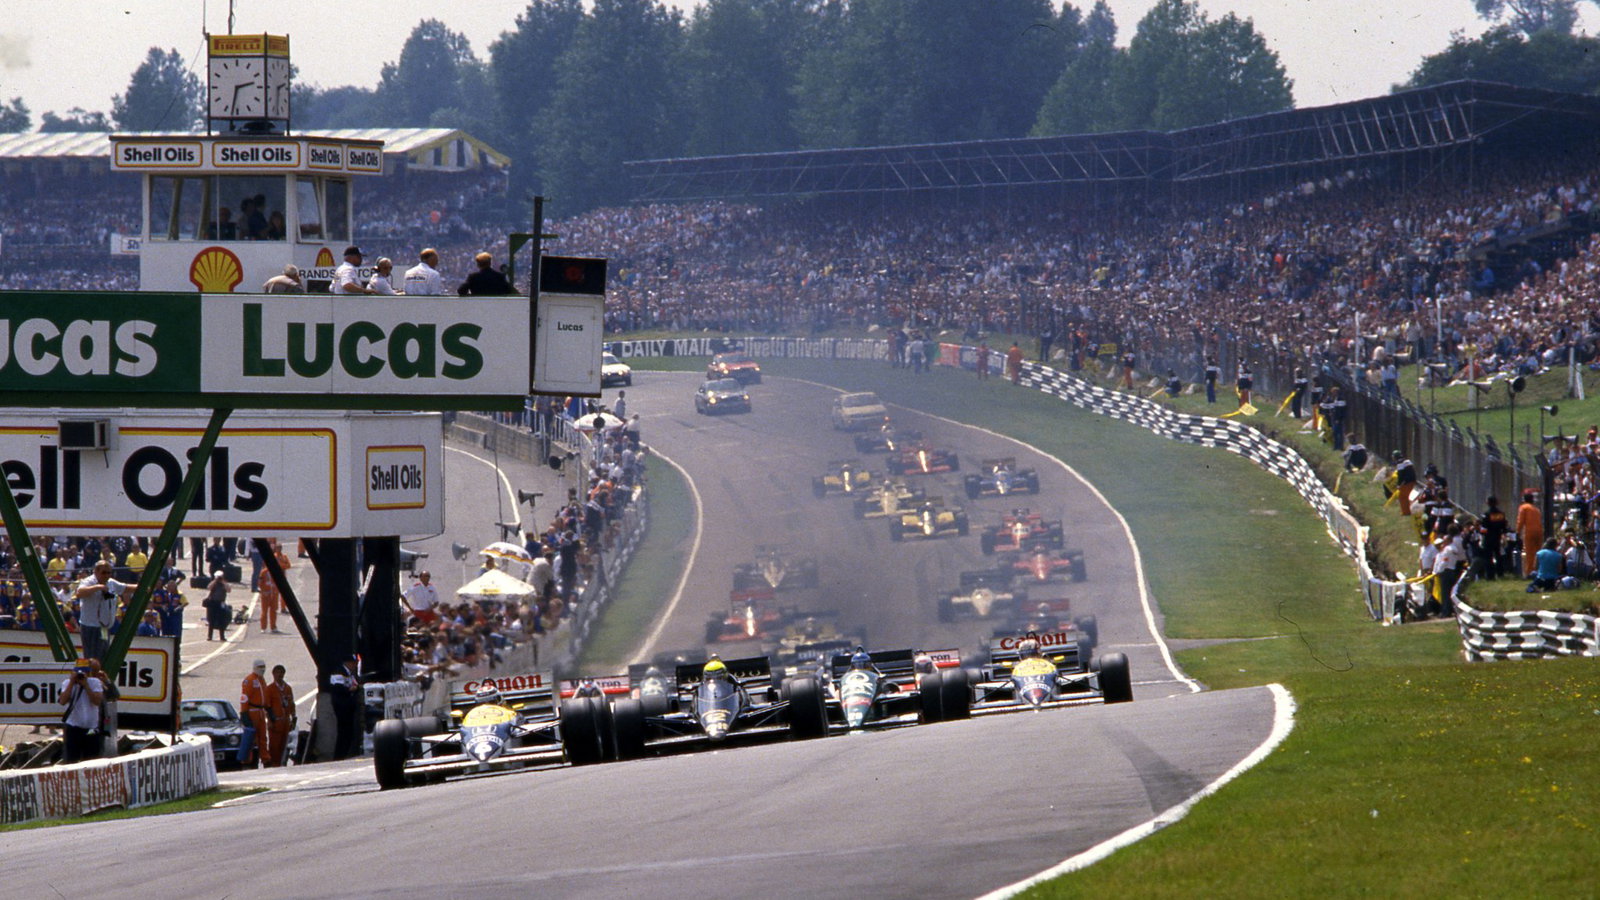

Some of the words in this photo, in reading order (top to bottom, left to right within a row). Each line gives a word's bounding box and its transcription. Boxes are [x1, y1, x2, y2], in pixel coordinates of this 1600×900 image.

[213, 38, 262, 50] PIRELLI
[124, 147, 162, 161] Shell
[164, 147, 195, 161] Oils
[221, 147, 259, 162] Shell
[262, 147, 292, 162] Oils
[311, 149, 327, 163] Shell
[327, 150, 340, 164] Oils
[350, 152, 365, 165] Shell
[366, 153, 379, 166] Oils
[299, 269, 336, 279] RANDS
[557, 321, 583, 331] Lucas
[0, 318, 158, 377] cas
[242, 303, 484, 379] Lucas
[621, 339, 667, 358] DAILY
[673, 338, 714, 356] MAIL
[744, 337, 785, 358] livetti
[371, 465, 398, 491] Shell
[401, 464, 422, 490] Oils
[1000, 632, 1067, 650] Con
[118, 661, 154, 688] ils
[464, 674, 542, 695] Cnon
[38, 770, 83, 818] TOYOTA
[84, 762, 128, 811] TOYOTA
[138, 754, 181, 804] PEUGEOT
